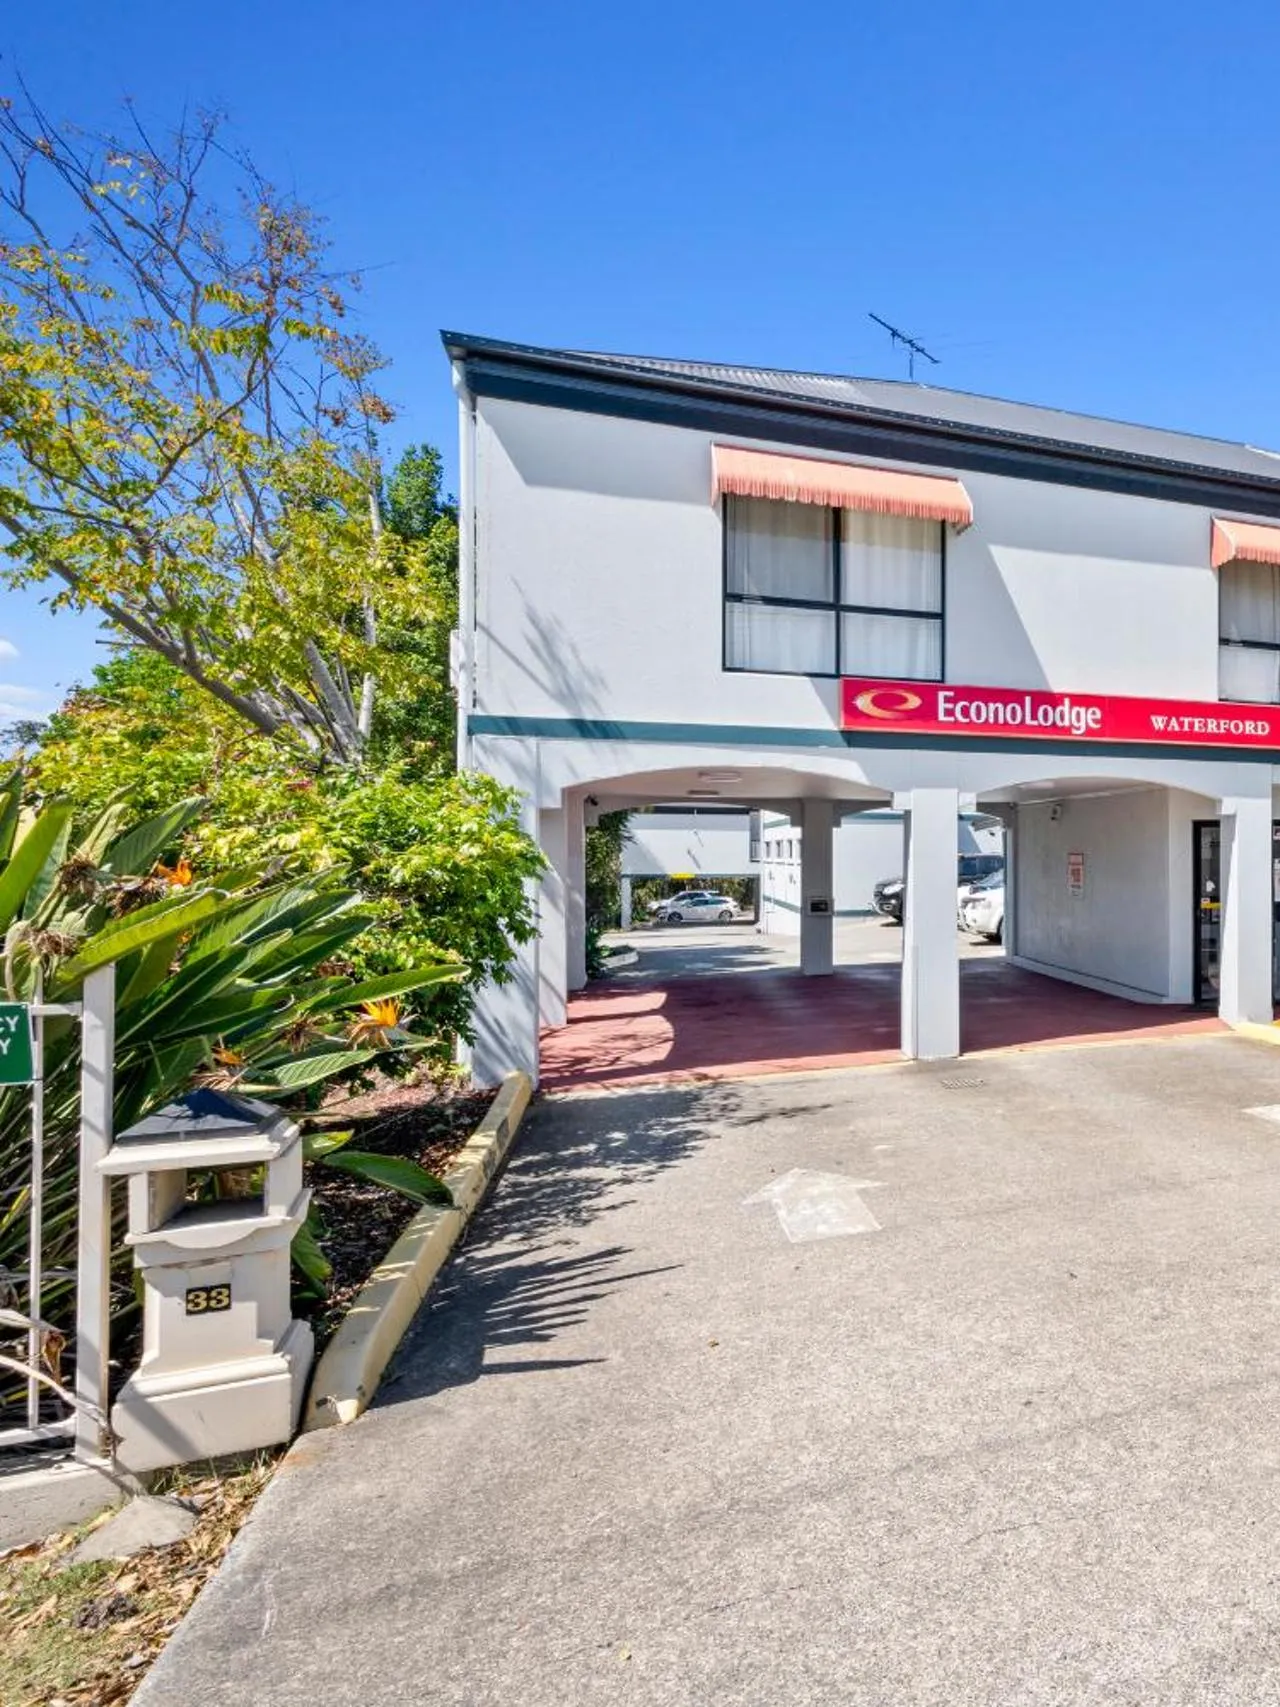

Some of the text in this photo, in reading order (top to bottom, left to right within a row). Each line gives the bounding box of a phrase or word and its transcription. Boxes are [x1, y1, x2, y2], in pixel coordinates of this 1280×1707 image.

[937, 690, 1270, 735] EconoLodge WATERFORD
[0, 1015, 20, 1033] Y
[187, 1288, 230, 1311] 33
